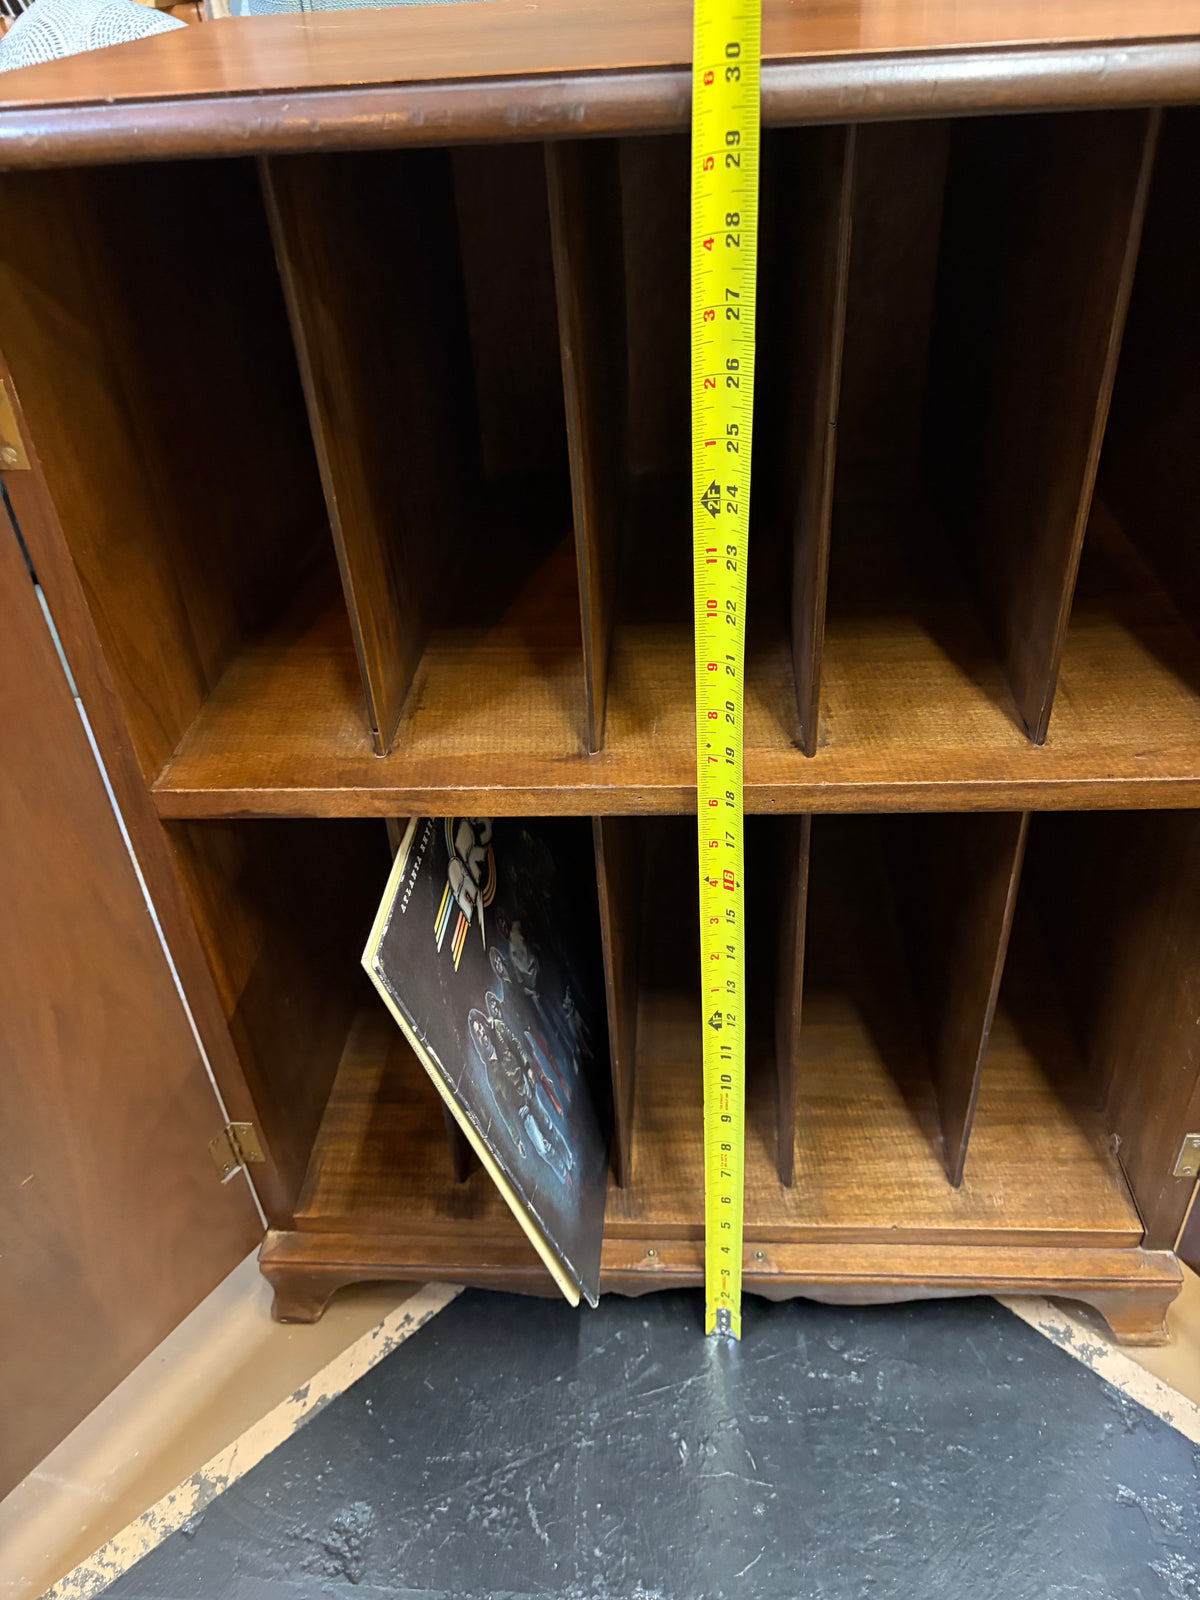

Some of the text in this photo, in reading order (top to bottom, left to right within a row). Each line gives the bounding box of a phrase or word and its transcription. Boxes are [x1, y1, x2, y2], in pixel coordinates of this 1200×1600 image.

[725, 42, 741, 82] 30
[703, 70, 714, 86] 6
[725, 130, 741, 168] 29
[702, 156, 714, 171] 5
[725, 212, 740, 248] 28
[702, 237, 715, 251] 4
[725, 288, 740, 321] 27
[703, 309, 715, 322] 3
[726, 358, 740, 389] 26
[704, 377, 716, 390] 2
[726, 423, 739, 453] 25
[726, 485, 738, 515] 24
[705, 547, 717, 564] 11
[726, 544, 737, 572] 23
[706, 599, 718, 618] 10
[726, 599, 736, 626] 22
[707, 663, 718, 671] 9
[726, 654, 735, 677] 21
[707, 711, 718, 720] 8
[725, 701, 735, 725] 20
[708, 756, 718, 764] 7
[725, 747, 735, 766] 19
[708, 799, 718, 807] 6
[725, 790, 735, 808] 18
[708, 840, 718, 848] 5
[725, 831, 735, 849] 17
[709, 880, 718, 888] 4
[723, 871, 734, 890] 16
[709, 917, 719, 925] 3
[725, 909, 735, 925] 15
[726, 944, 735, 961] 14
[726, 980, 736, 995] 13
[726, 1013, 736, 1028] 12
[720, 1044, 732, 1060] 11
[720, 1074, 732, 1091] 10
[720, 1115, 732, 1123] 9
[720, 1143, 731, 1151] 8
[720, 1170, 731, 1178] 7
[720, 1196, 731, 1205] 6
[720, 1222, 731, 1230] 5
[720, 1246, 731, 1254] 4
[720, 1268, 731, 1276] 3
[720, 1291, 730, 1299] 2
